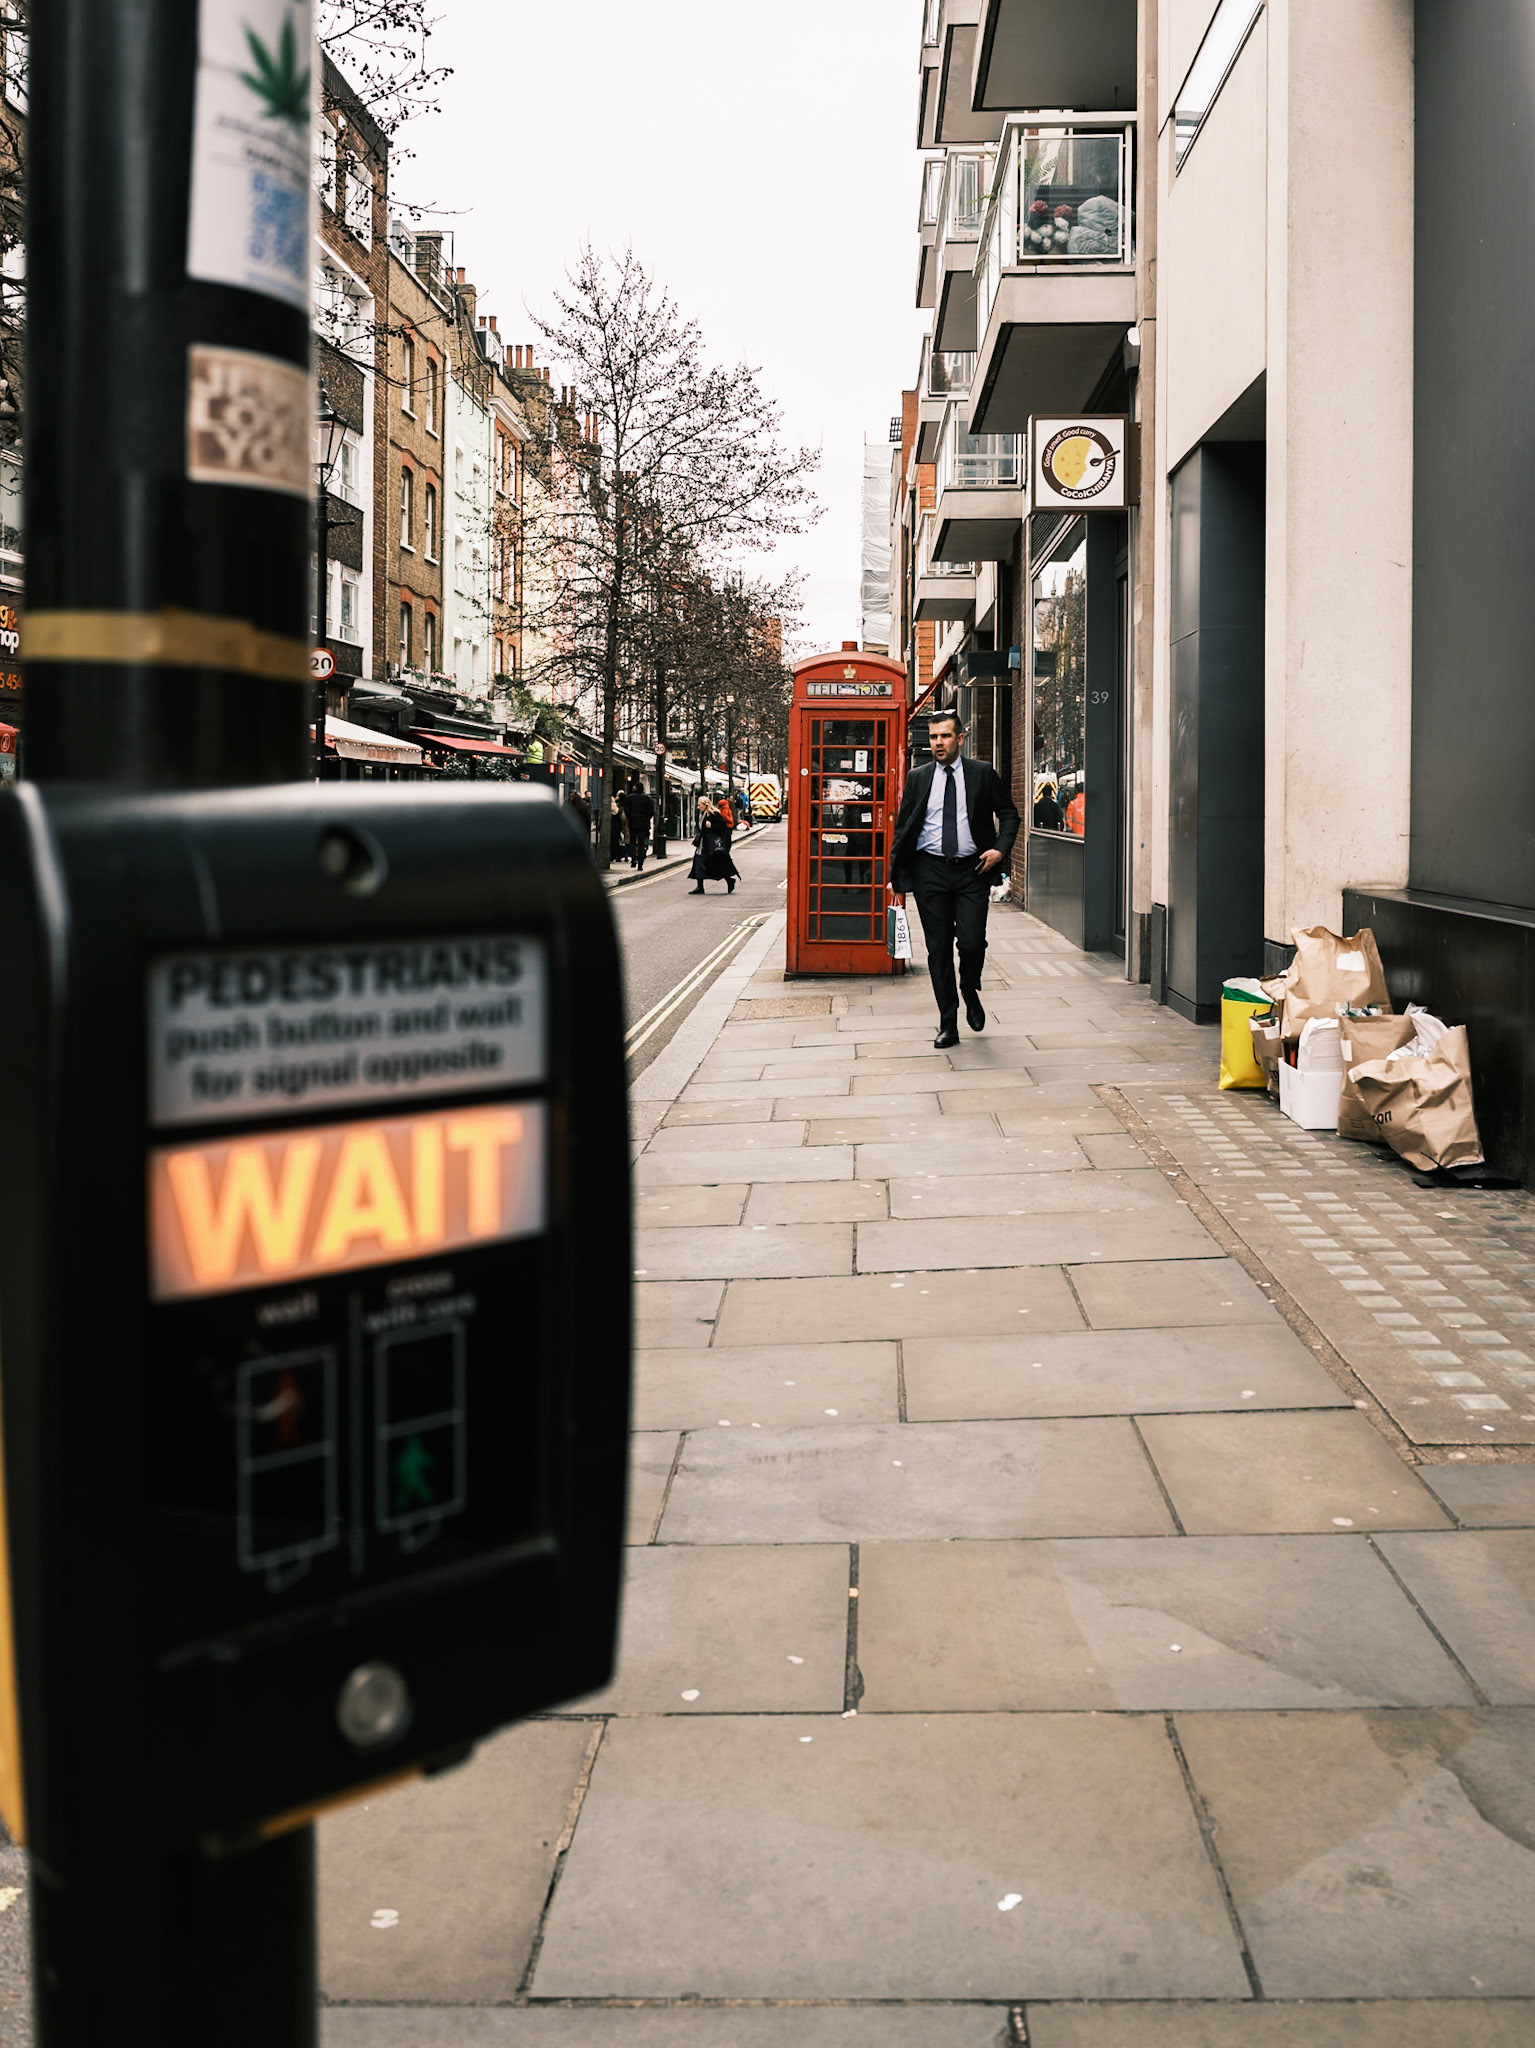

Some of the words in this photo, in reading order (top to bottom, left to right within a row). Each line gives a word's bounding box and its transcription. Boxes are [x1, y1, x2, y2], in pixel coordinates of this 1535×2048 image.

[1043, 448, 1053, 467] Good
[1062, 427, 1080, 438] Good
[1080, 428, 1097, 438] curry
[311, 657, 332, 670] 20
[1091, 690, 1109, 704] 39
[897, 917, 907, 943] 1864
[169, 943, 523, 1007] PEDESTRIANS
[166, 1016, 261, 1062] push
[266, 1009, 381, 1049] button
[387, 1004, 450, 1035] and
[456, 995, 523, 1028] wait
[191, 1064, 242, 1098] for
[252, 1052, 358, 1095] signal
[363, 1038, 504, 1083] opposite
[167, 1110, 524, 1287] WAIT
